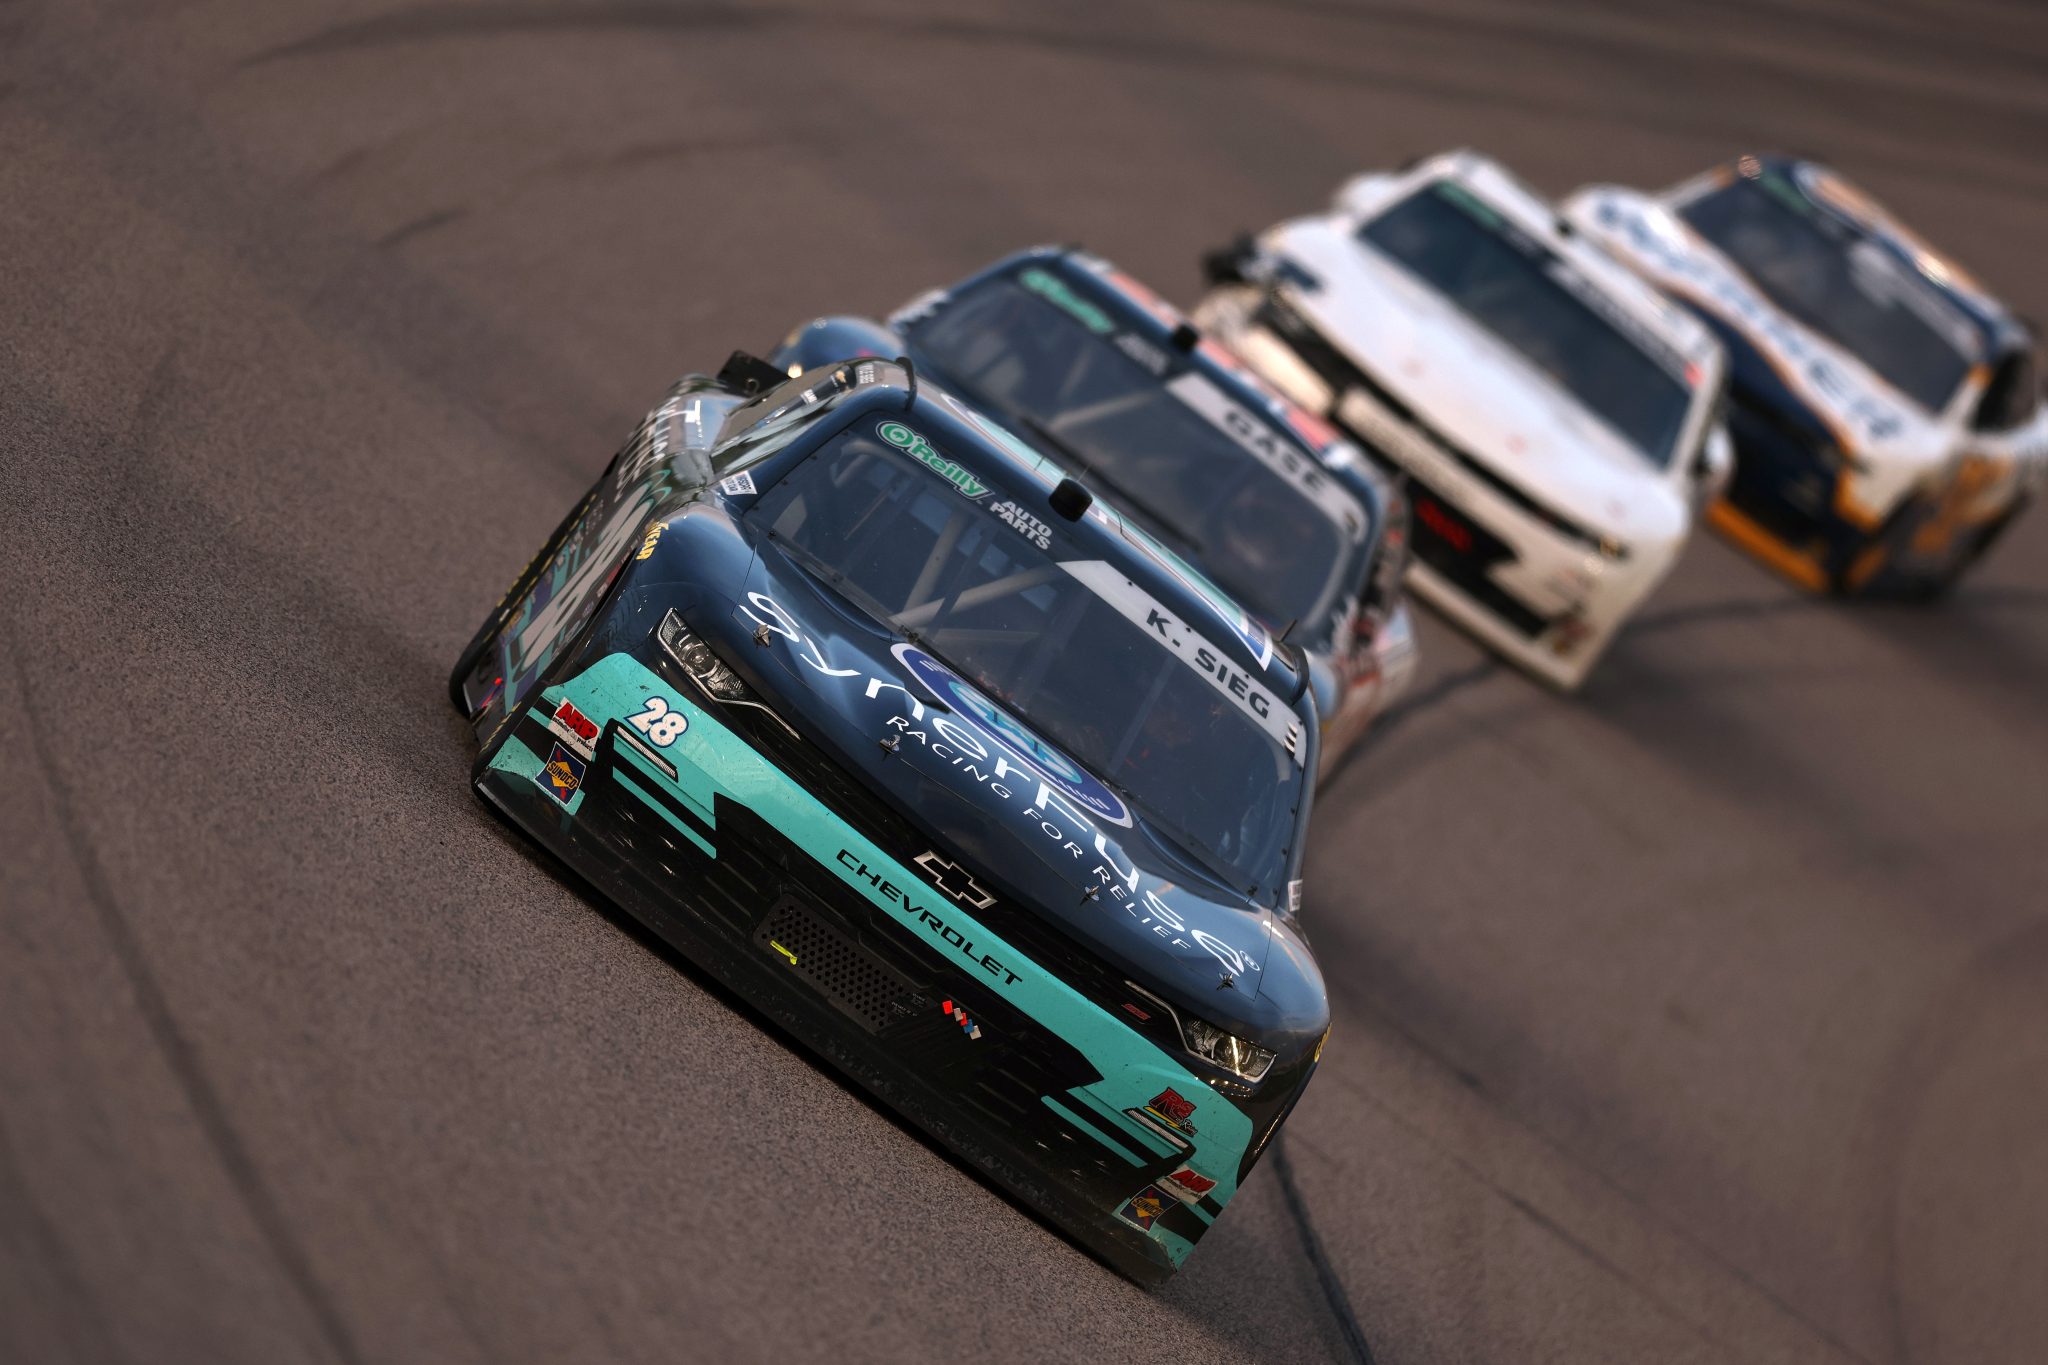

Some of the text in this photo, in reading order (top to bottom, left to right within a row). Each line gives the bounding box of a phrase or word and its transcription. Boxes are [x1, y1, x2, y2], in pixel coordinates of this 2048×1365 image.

[878, 421, 992, 498] O'Reilly
[989, 501, 1051, 551] PARTS
[1001, 500, 1053, 538] AUTO
[1146, 608, 1270, 720] K. SIEG
[555, 702, 598, 740] ARP
[623, 695, 689, 748] 28
[547, 759, 579, 791] SUNOCO
[885, 714, 1191, 951] RACING FOR RELIEF
[836, 848, 1023, 986] CHEVROLET
